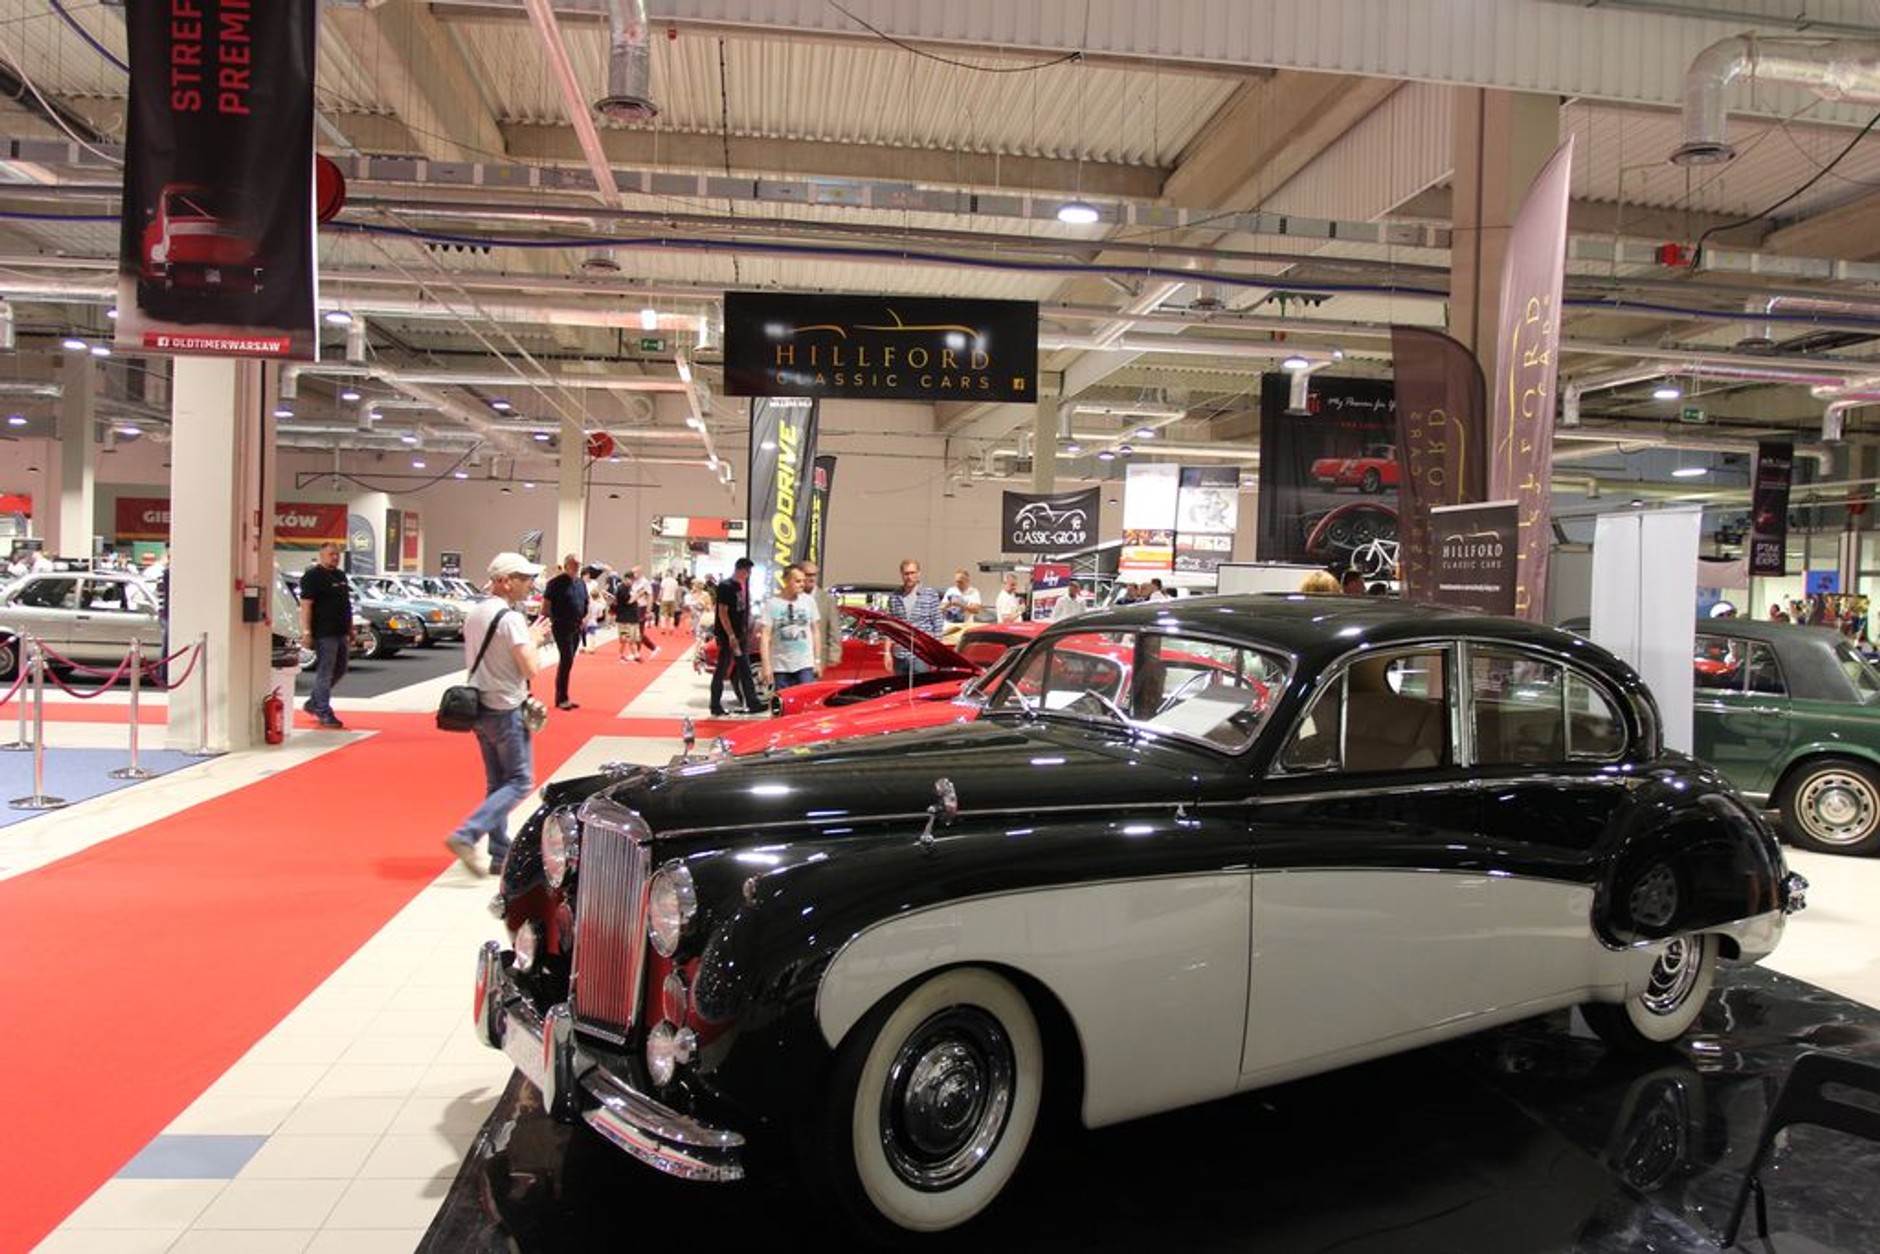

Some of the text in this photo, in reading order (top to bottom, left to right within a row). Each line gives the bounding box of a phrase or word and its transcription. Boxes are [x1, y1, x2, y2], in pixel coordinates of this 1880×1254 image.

[171, 338, 281, 352] OLDTIMERWARSAW
[776, 344, 990, 370] HILLFORD
[776, 372, 990, 389] CLASSIC CARS
[142, 510, 318, 528] GIE KÓW
[1443, 543, 1503, 558] HILLFORD
